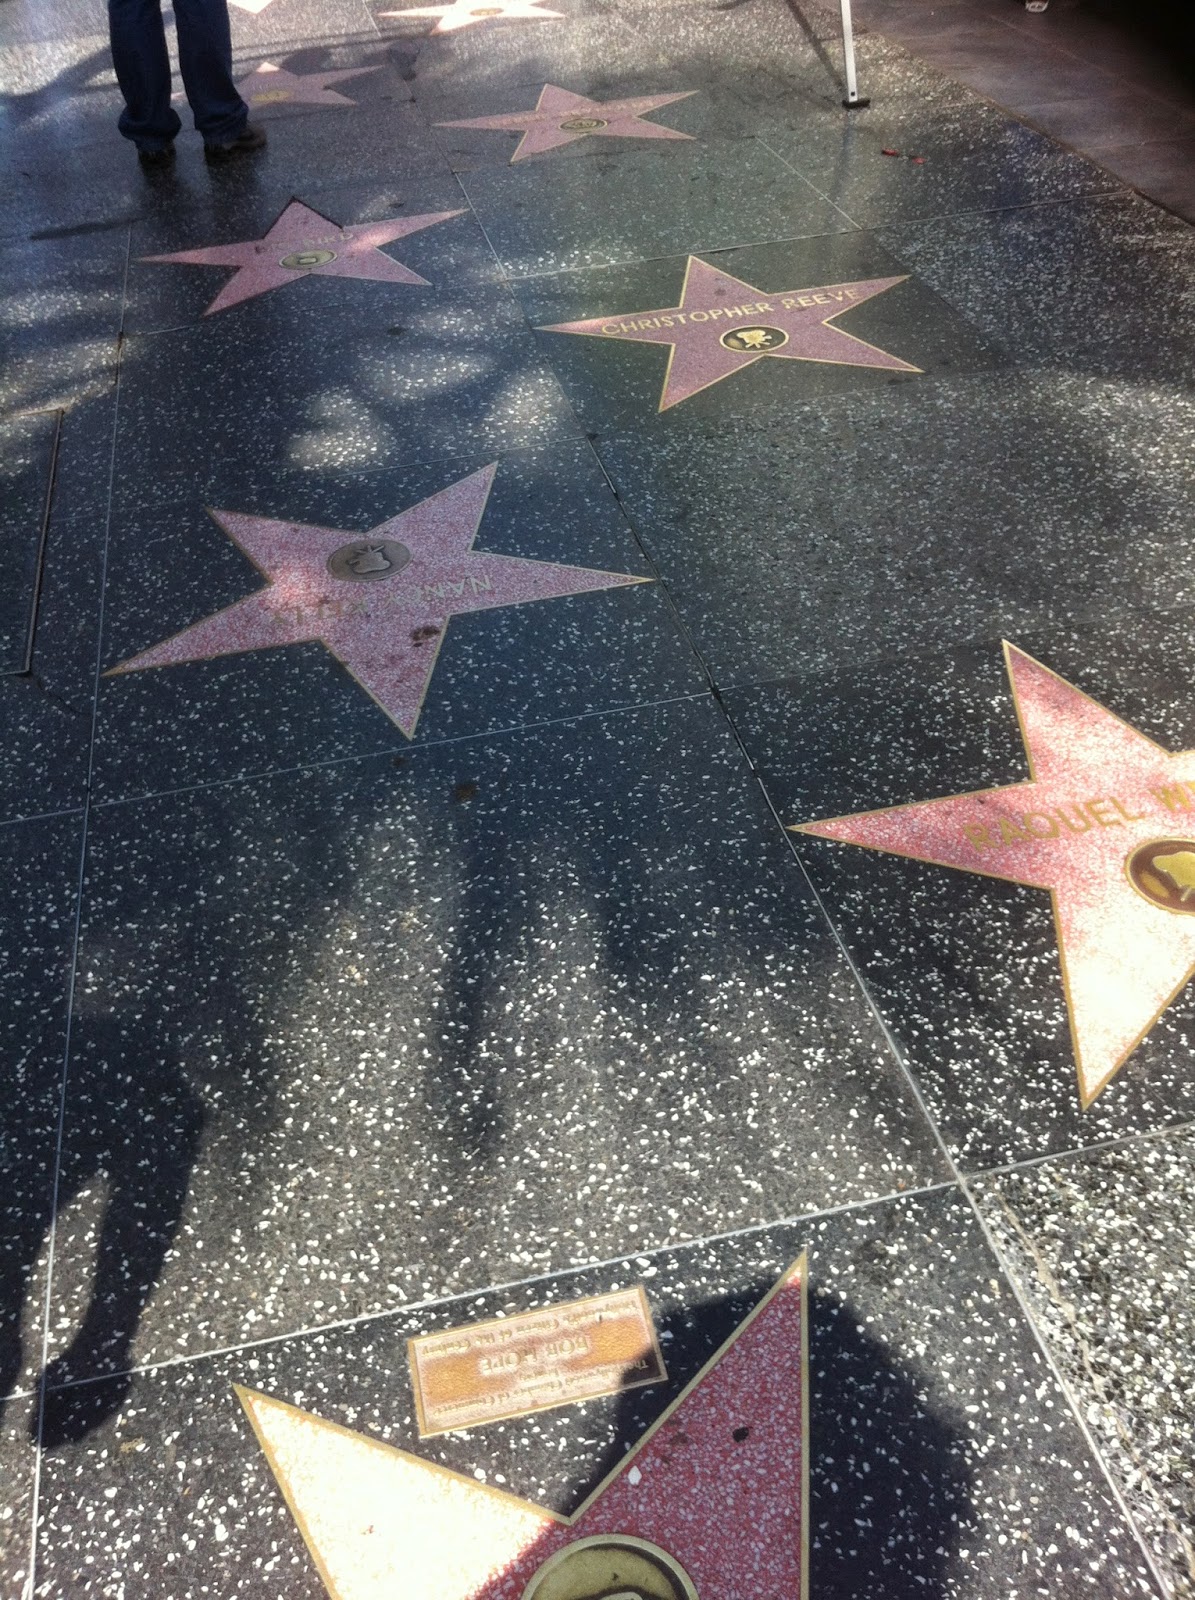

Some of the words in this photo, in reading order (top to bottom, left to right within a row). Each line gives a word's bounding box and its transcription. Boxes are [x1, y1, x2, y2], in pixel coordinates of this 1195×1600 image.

[600, 301, 774, 336] CHRISTOPHER
[781, 288, 859, 310] REEVE
[385, 574, 493, 607] NANCY
[963, 796, 1147, 854] RAQUEL
[498, 1328, 512, 1342] of
[546, 1335, 590, 1359] BOB
[479, 1347, 538, 1375] HOPE
